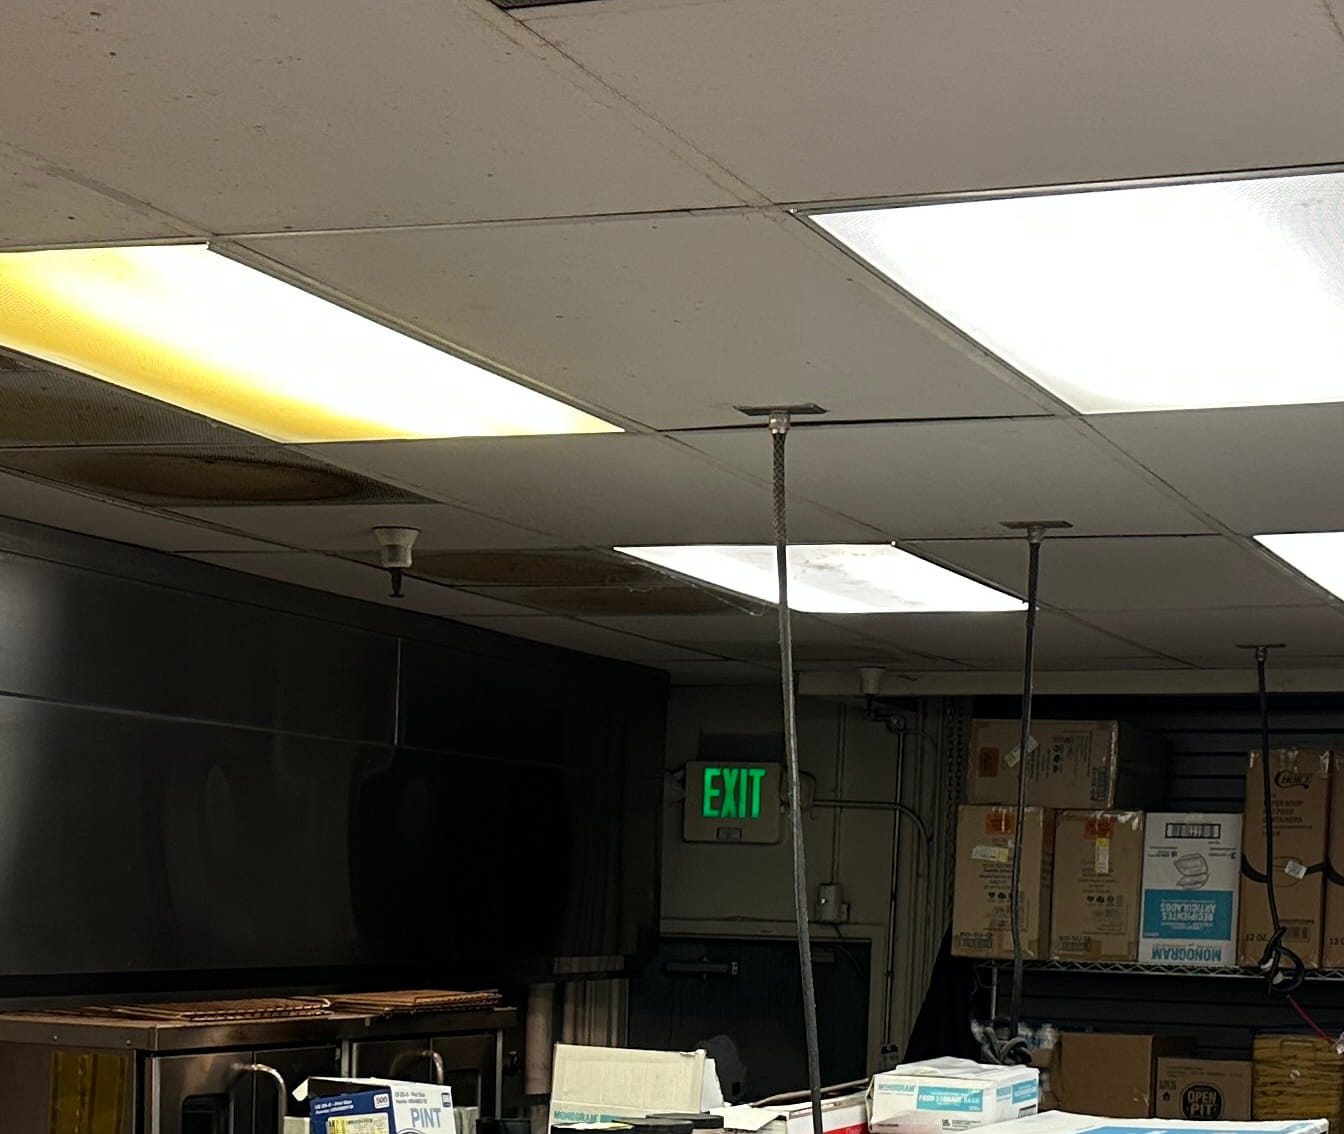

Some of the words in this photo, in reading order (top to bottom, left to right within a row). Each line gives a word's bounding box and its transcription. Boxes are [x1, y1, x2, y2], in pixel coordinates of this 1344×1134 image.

[703, 768, 767, 818] EXIT
[1152, 946, 1221, 962] MONOGRAM
[1187, 1089, 1217, 1104] OPEN
[553, 1111, 598, 1123] MONOGRAM
[1189, 1104, 1213, 1117] PIT
[410, 1108, 442, 1129] PINT
